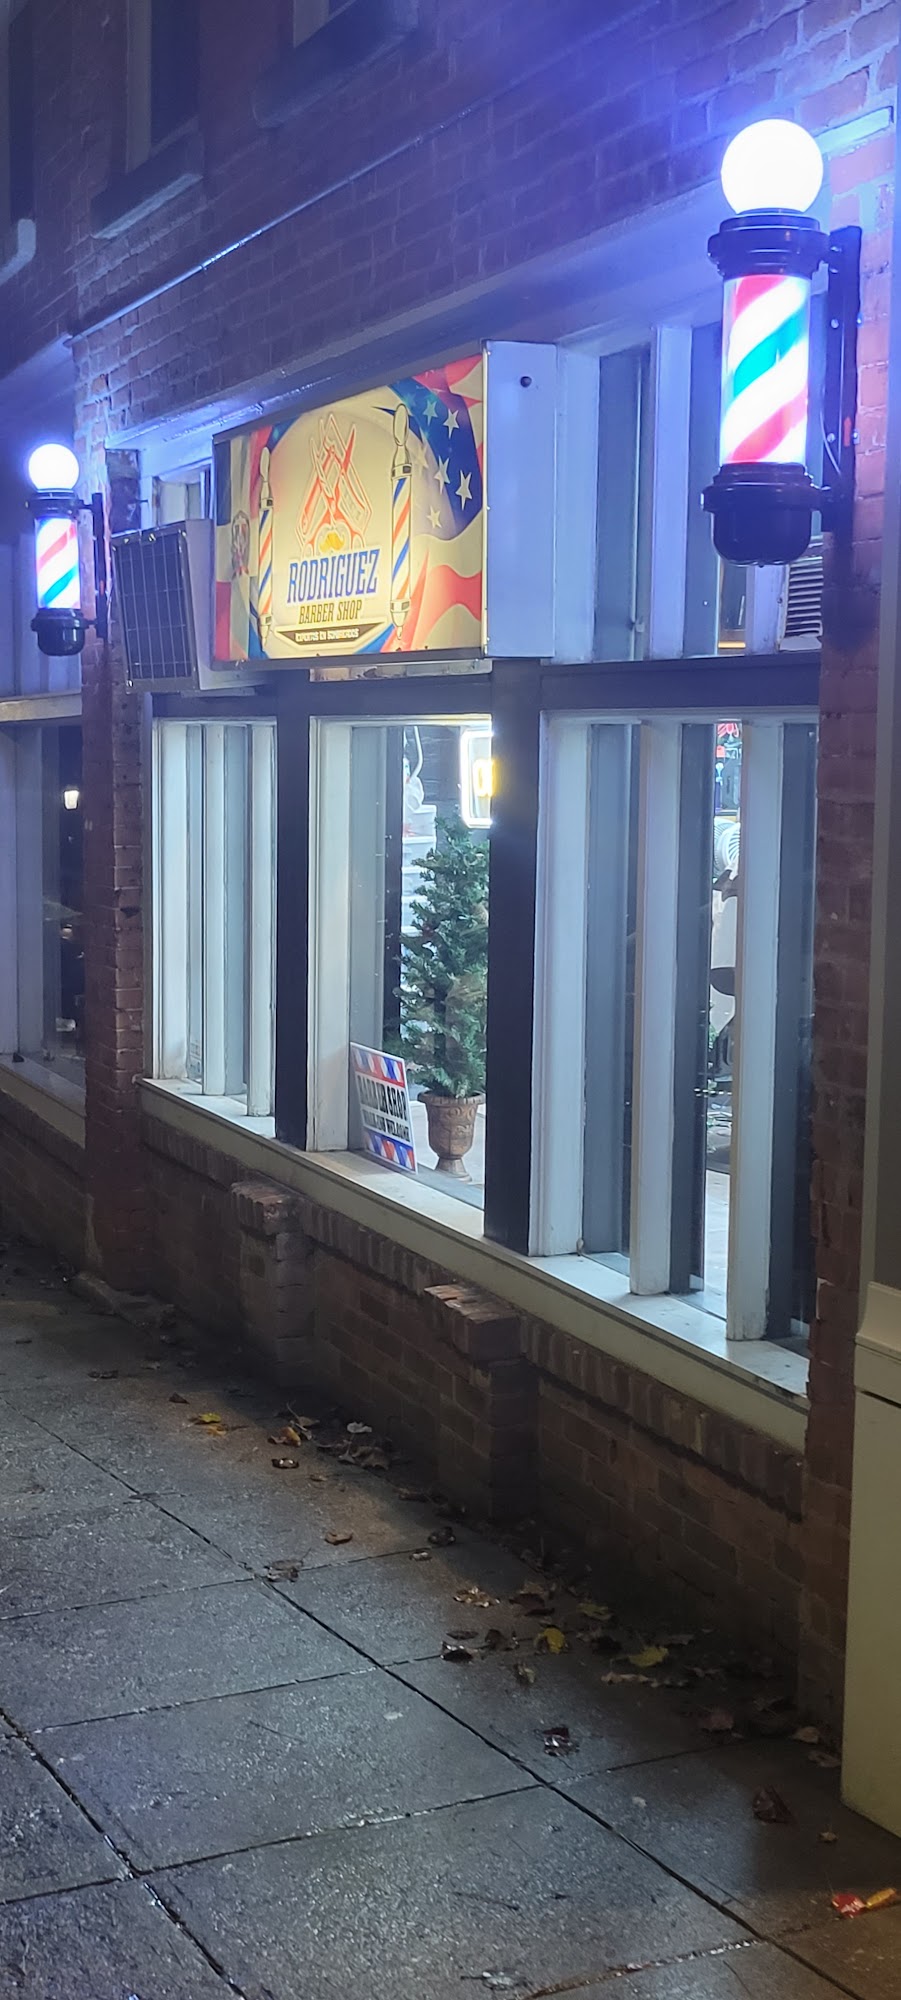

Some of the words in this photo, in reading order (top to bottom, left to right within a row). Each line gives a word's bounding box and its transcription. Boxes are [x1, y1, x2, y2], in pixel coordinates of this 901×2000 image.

[287, 549, 381, 603] RODRIGUEZ
[299, 603, 335, 625] BARBER
[337, 600, 362, 620] SHOP
[387, 1086, 407, 1120] SHOP
